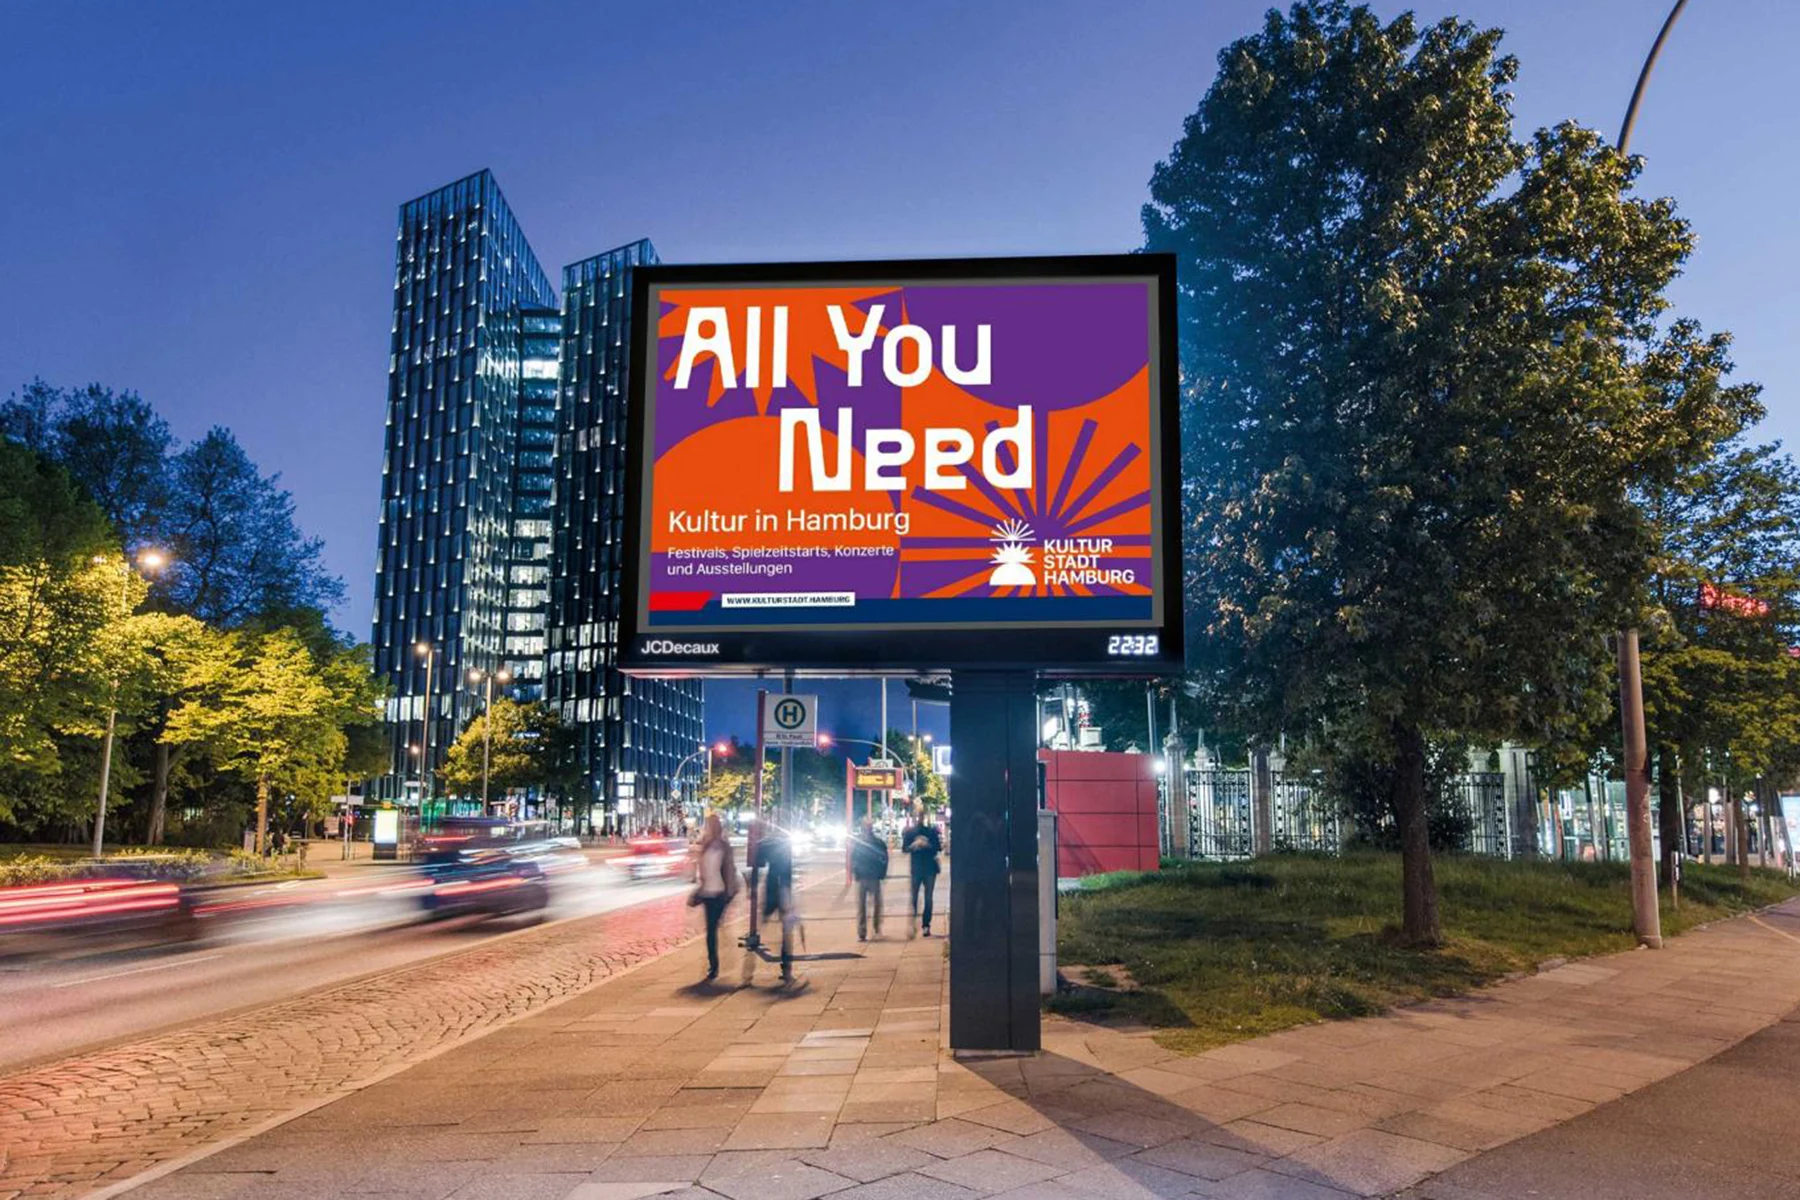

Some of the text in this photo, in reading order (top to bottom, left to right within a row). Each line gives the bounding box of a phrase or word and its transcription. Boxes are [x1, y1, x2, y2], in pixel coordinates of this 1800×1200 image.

[674, 304, 992, 390] All You
[779, 405, 1033, 492] Need
[669, 508, 910, 535] Kultur in Hamburg
[667, 544, 894, 560] Festivals, Spielzeitstarts, Konzerte
[1044, 538, 1113, 554] KULTUR
[667, 561, 793, 576] und Ausstellungen
[1043, 554, 1101, 570] STADT
[1044, 569, 1136, 585] HAMBURG
[641, 640, 719, 654] JCDecaux
[783, 705, 797, 722] H
